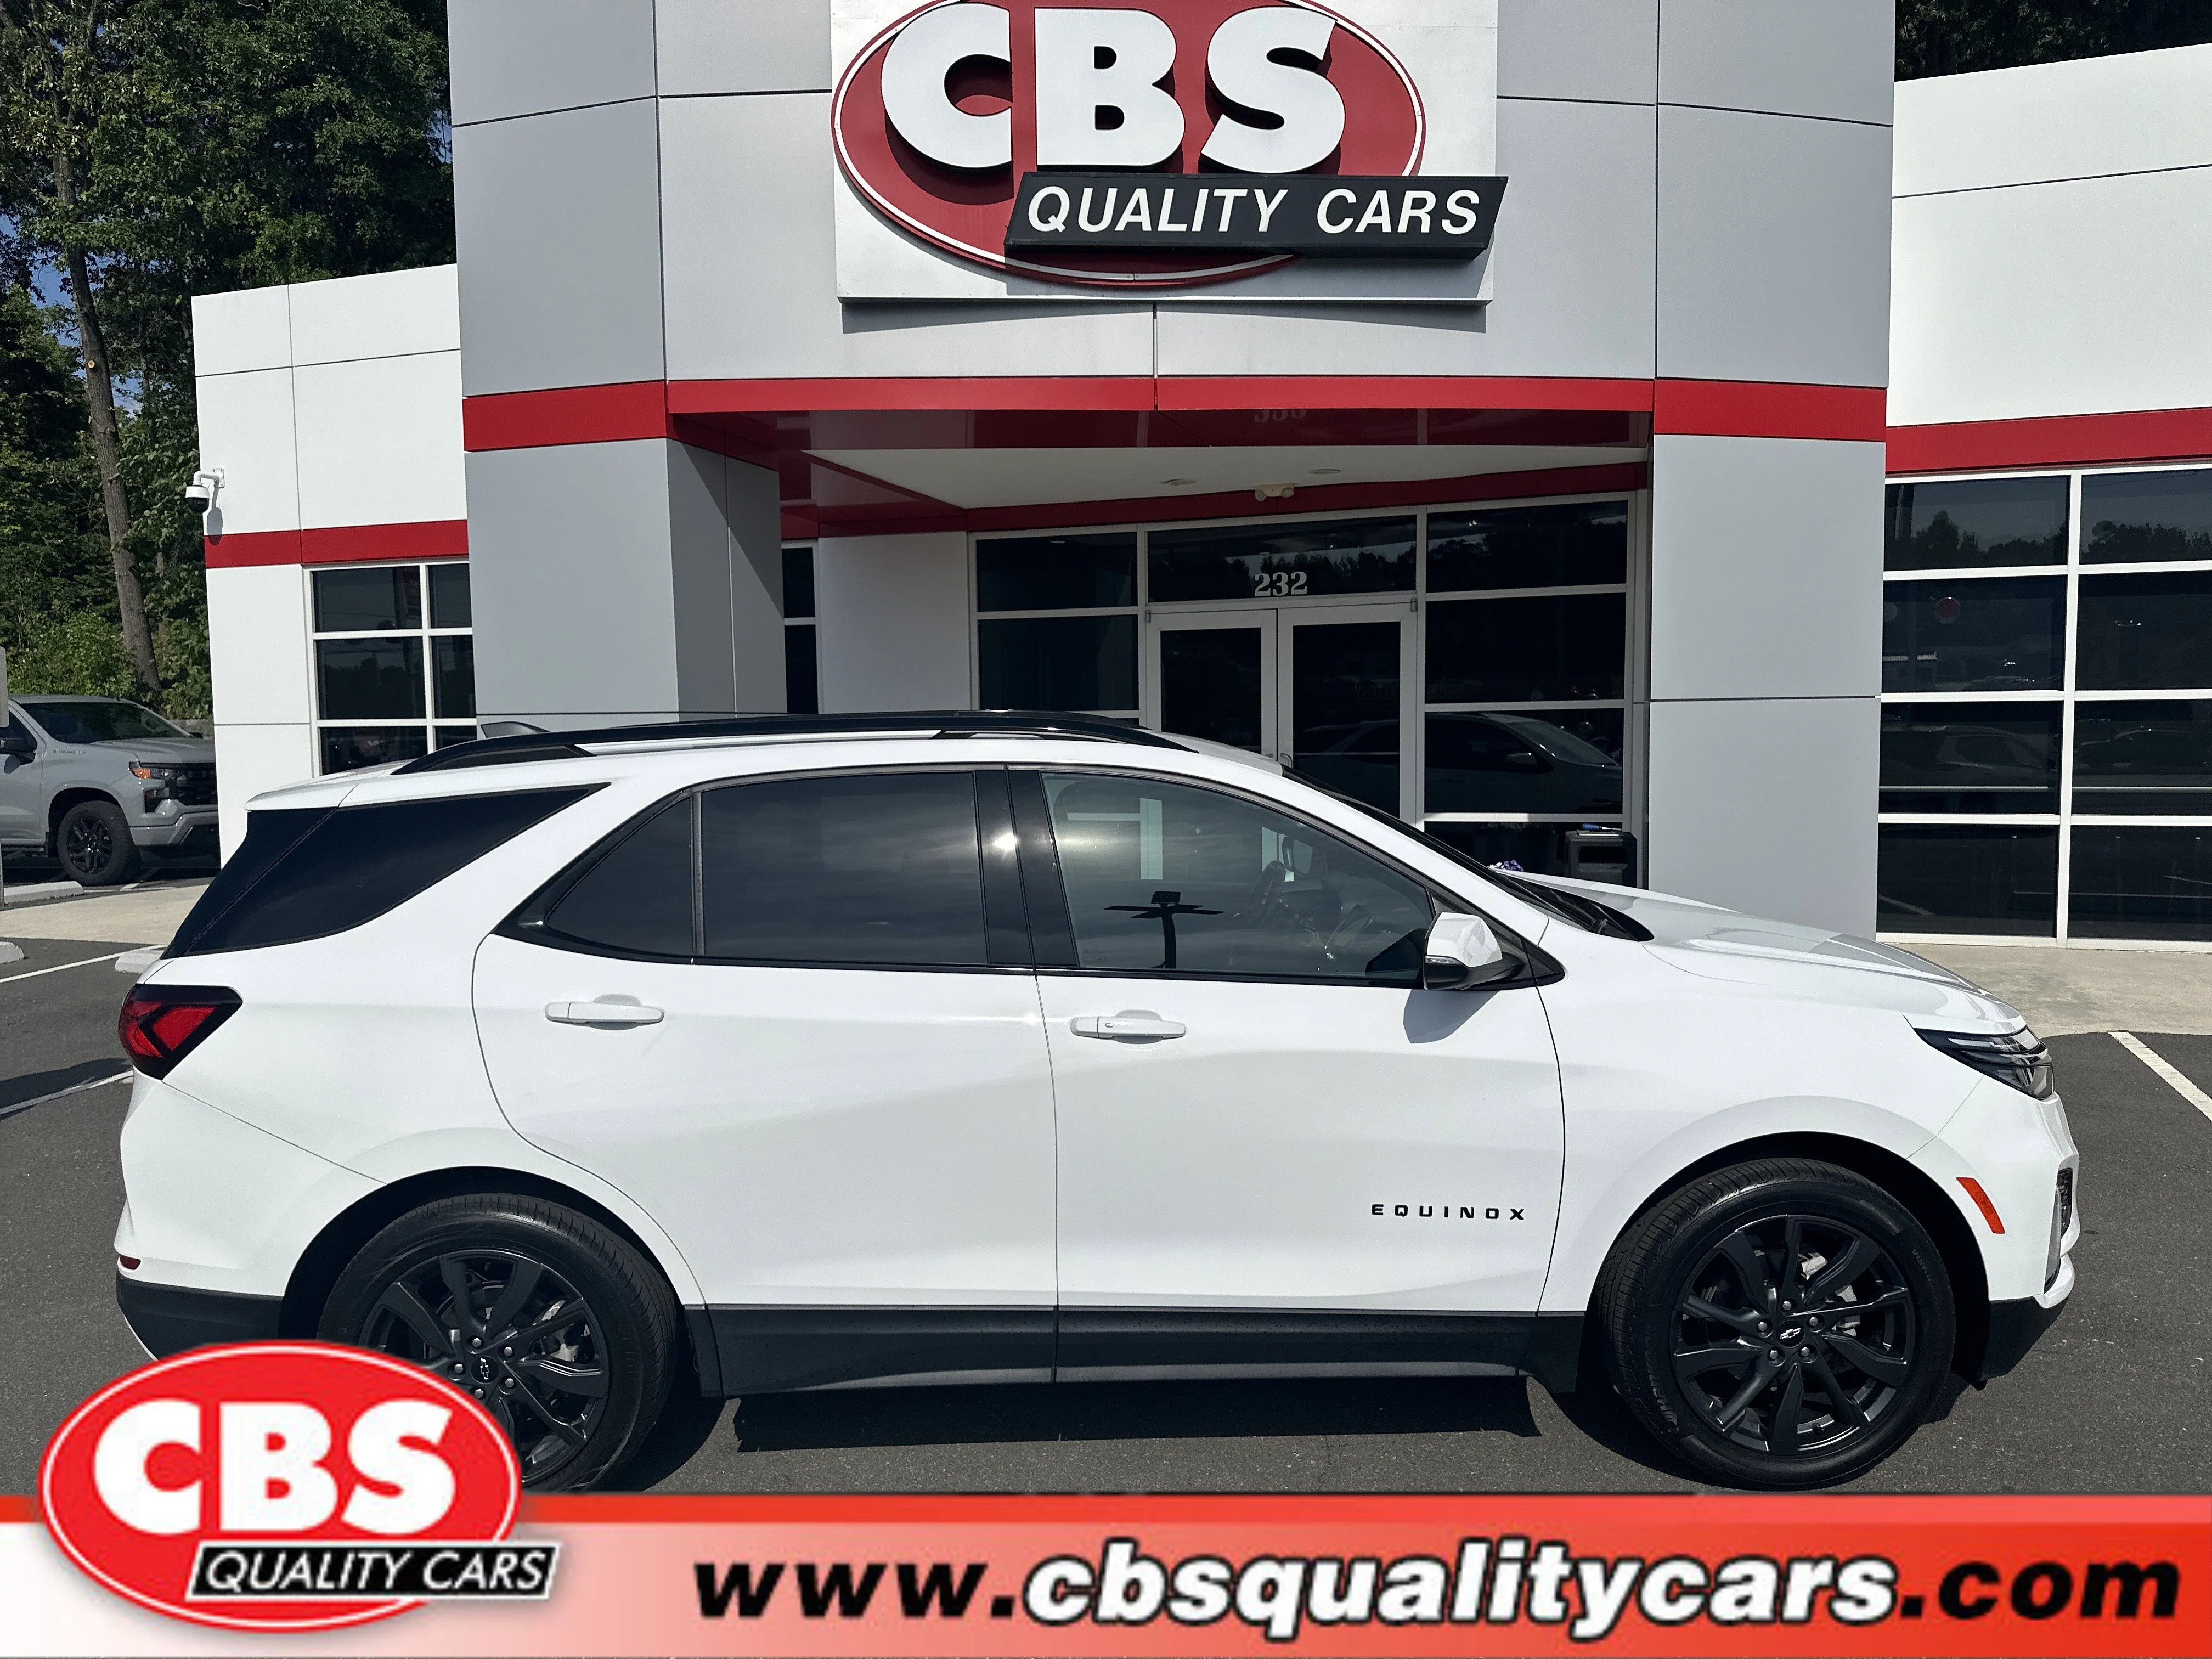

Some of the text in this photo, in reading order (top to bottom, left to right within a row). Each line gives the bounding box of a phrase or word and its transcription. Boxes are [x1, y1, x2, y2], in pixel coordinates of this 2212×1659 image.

[881, 2, 1346, 173] CBS
[1028, 186, 1478, 234] QUALITY CARS
[1254, 571, 1307, 597] 232
[1372, 1204, 1524, 1220] EQUINOX
